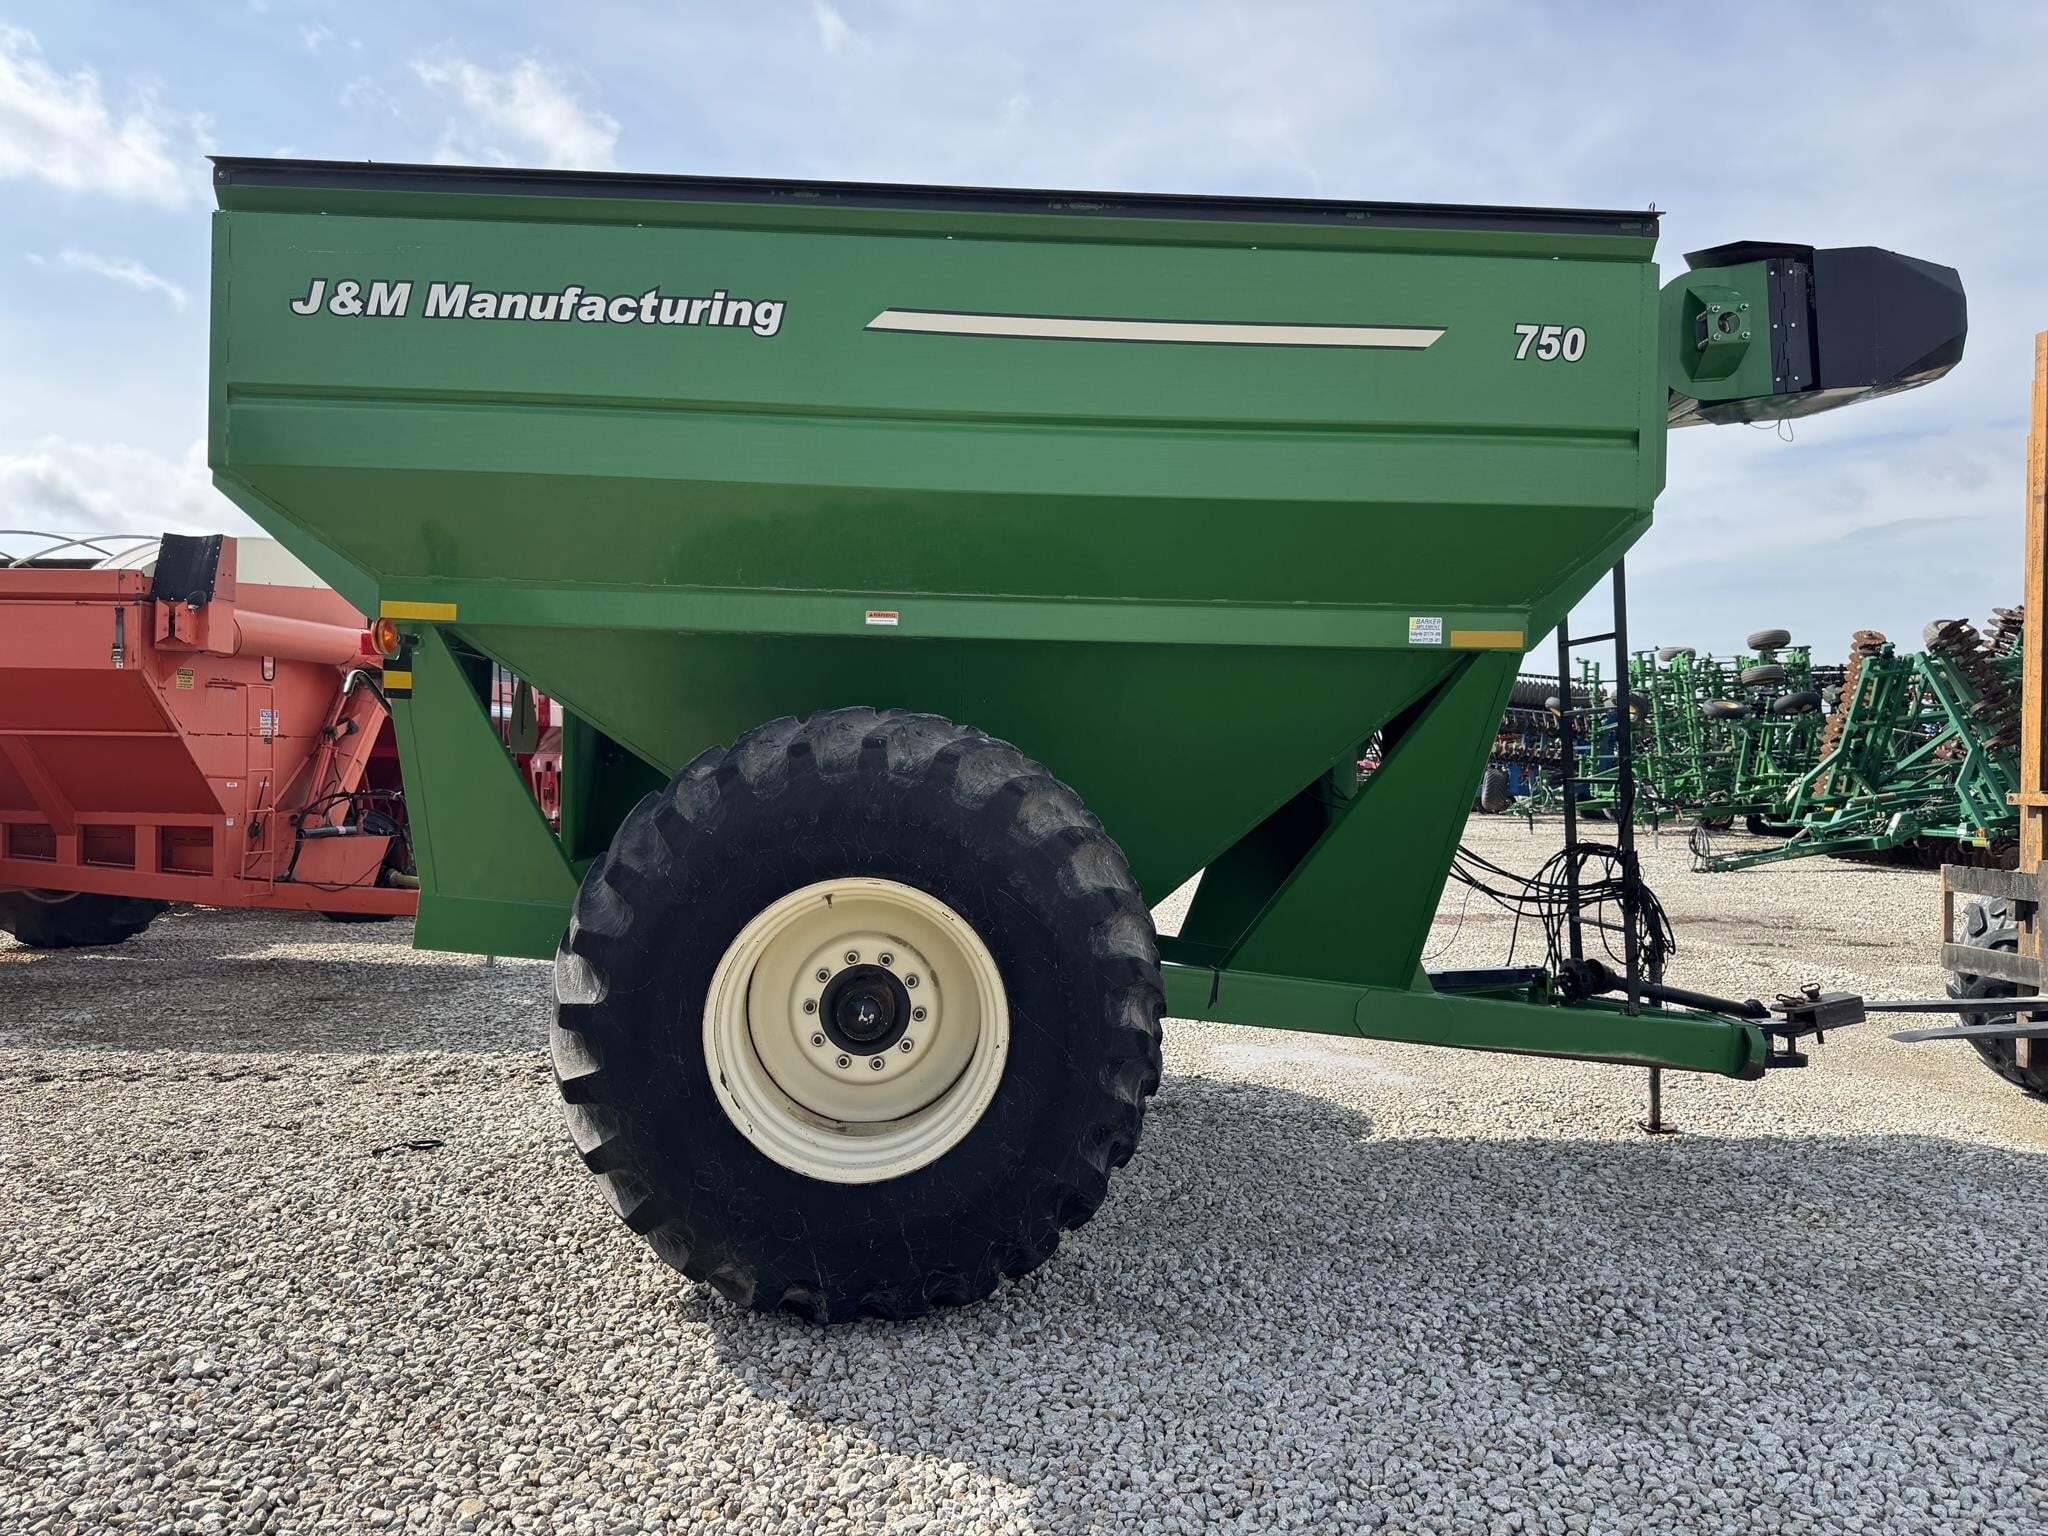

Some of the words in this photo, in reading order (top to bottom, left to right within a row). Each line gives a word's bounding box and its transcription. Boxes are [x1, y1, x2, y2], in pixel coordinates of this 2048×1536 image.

[291, 279, 413, 317] J&M
[423, 282, 786, 336] Manufacturing
[1515, 323, 1586, 362] 750
